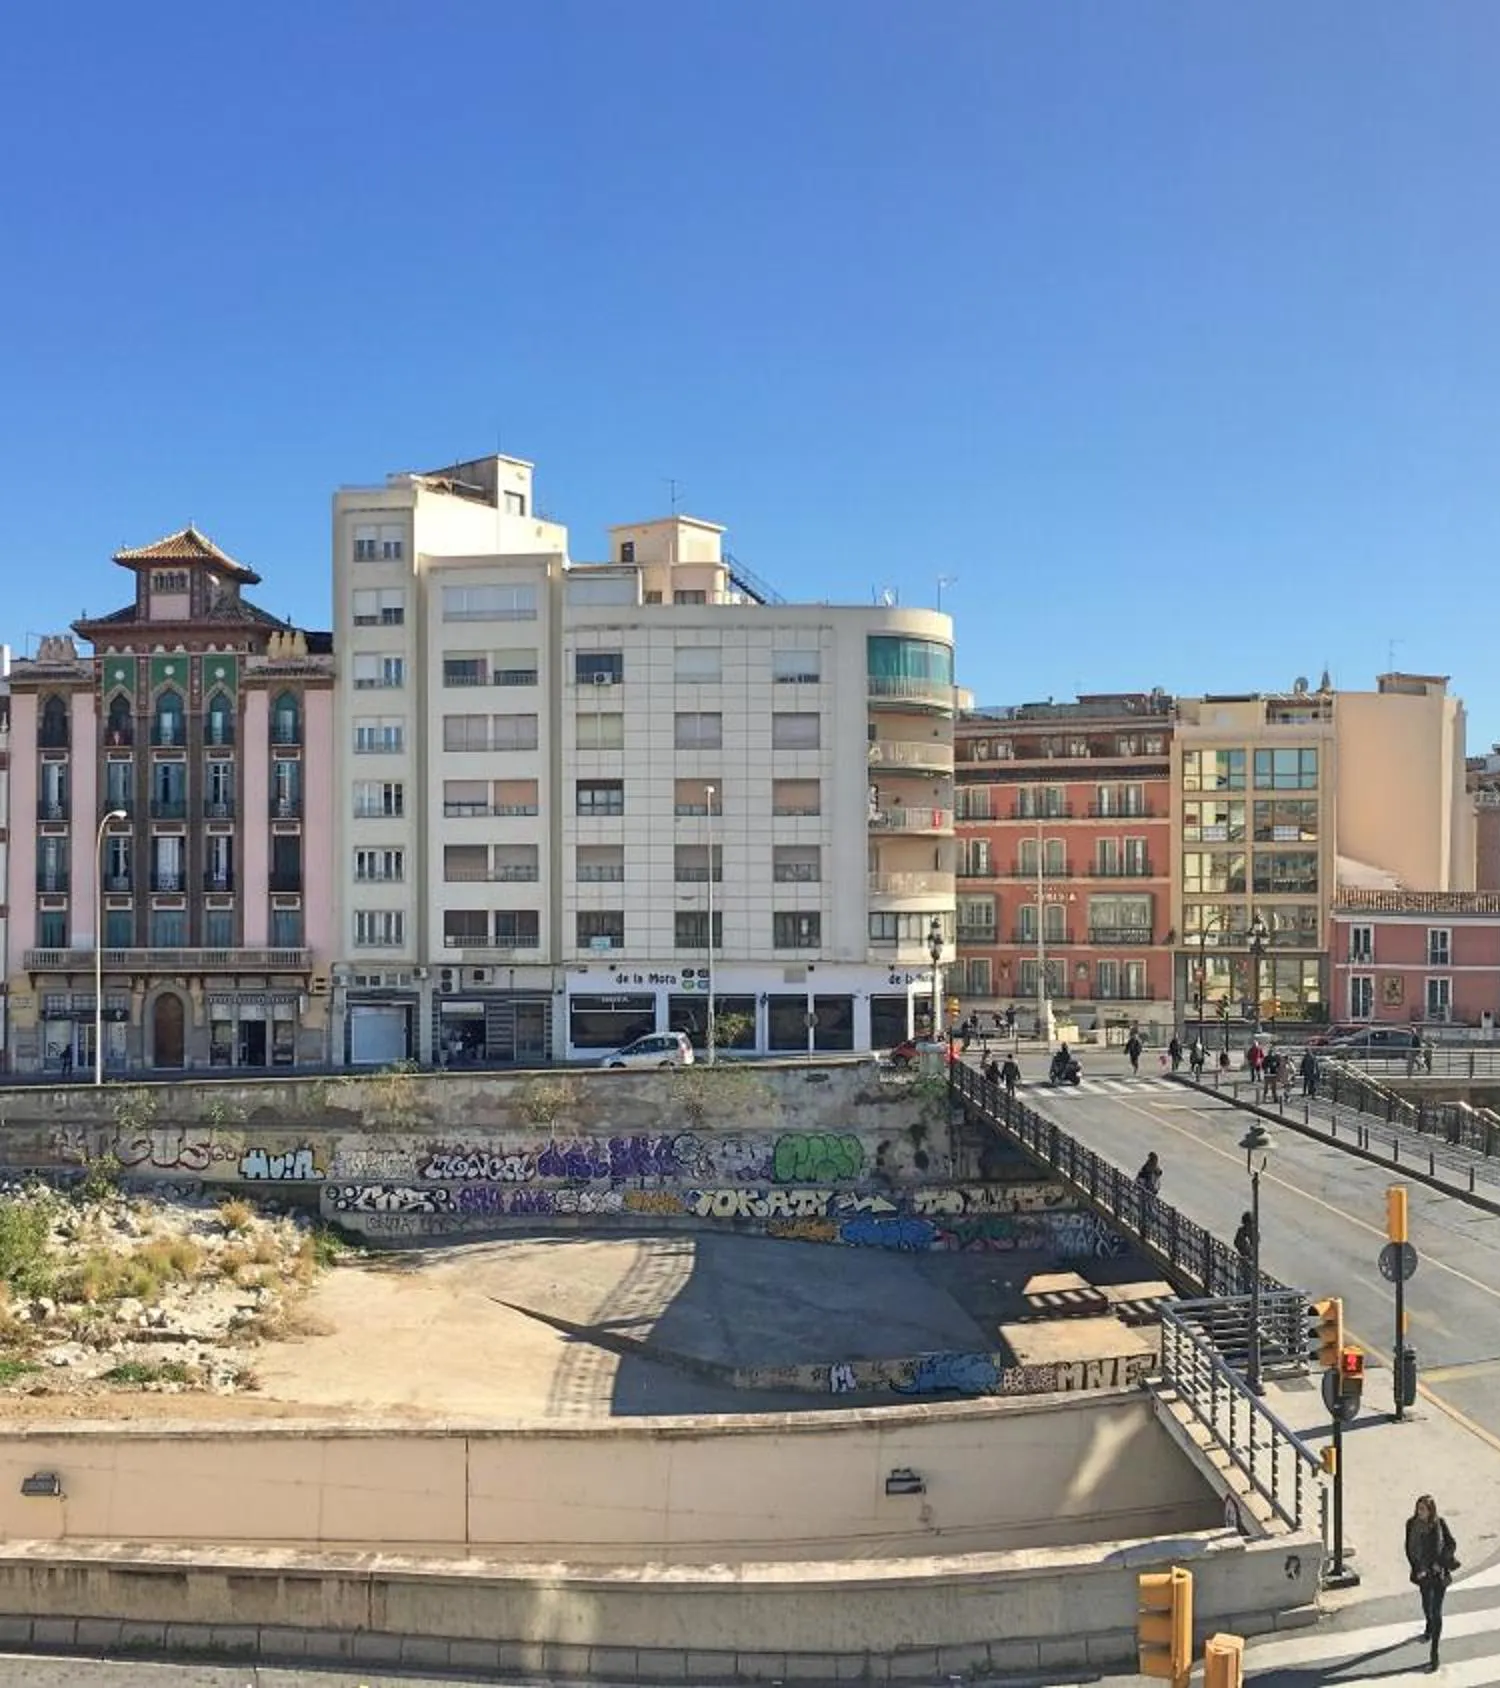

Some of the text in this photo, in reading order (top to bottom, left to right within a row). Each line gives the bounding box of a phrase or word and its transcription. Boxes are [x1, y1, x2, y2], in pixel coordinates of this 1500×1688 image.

[616, 973, 629, 985] de
[633, 973, 643, 985] la
[649, 973, 677, 985] Mora
[888, 974, 901, 985] de
